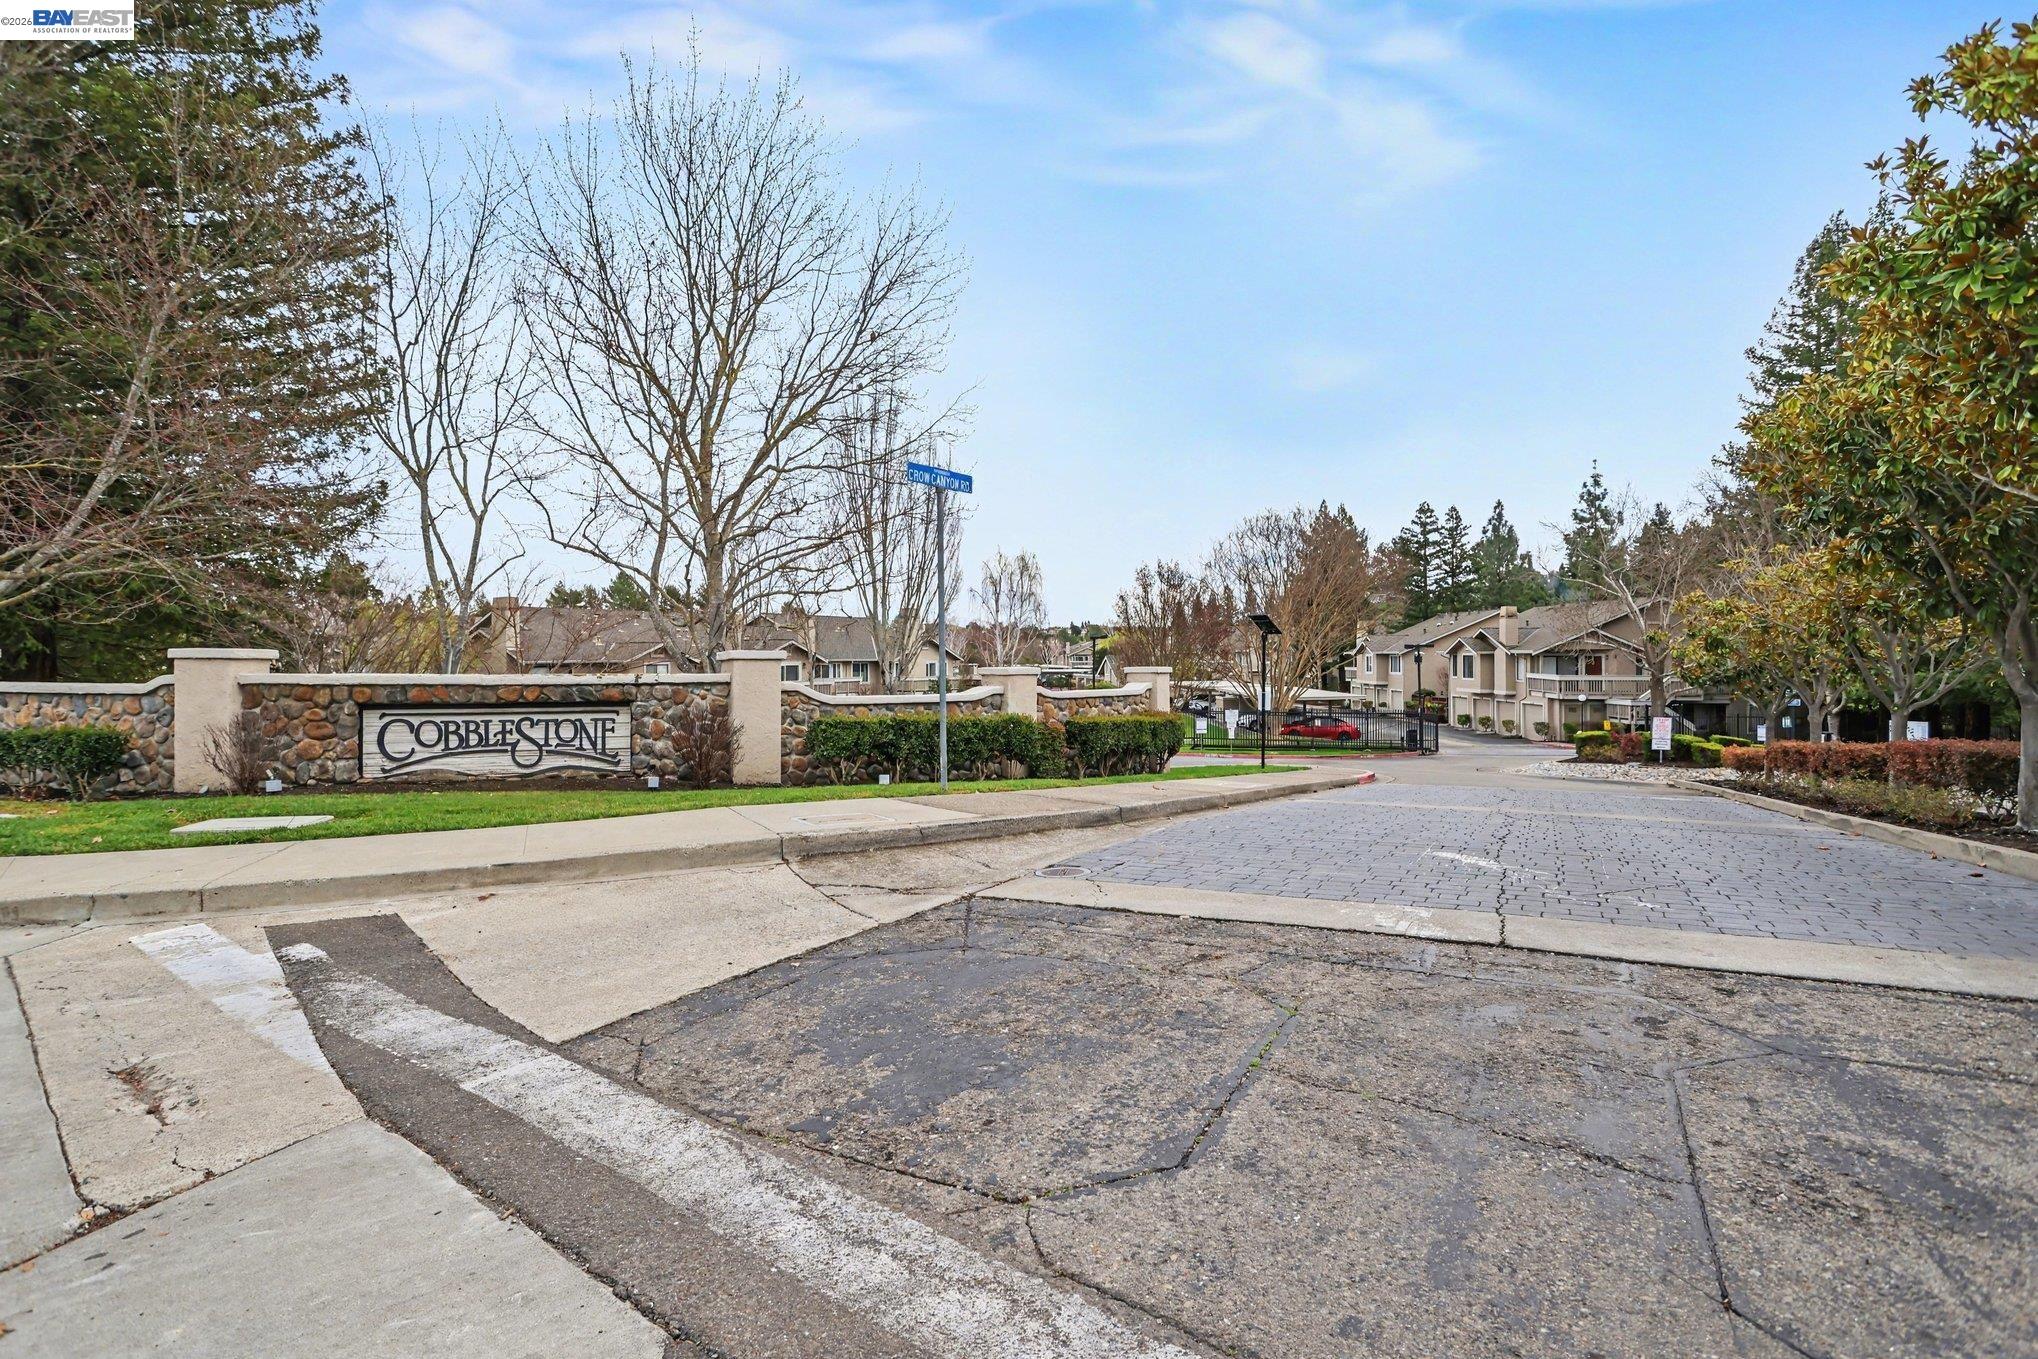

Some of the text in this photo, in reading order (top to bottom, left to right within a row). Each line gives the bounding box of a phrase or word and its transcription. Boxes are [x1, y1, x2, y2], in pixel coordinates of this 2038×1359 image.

[908, 469, 930, 484] CROW
[931, 473, 959, 490] CANYON
[960, 480, 970, 492] RD
[377, 716, 619, 768] COBBLESTONE
